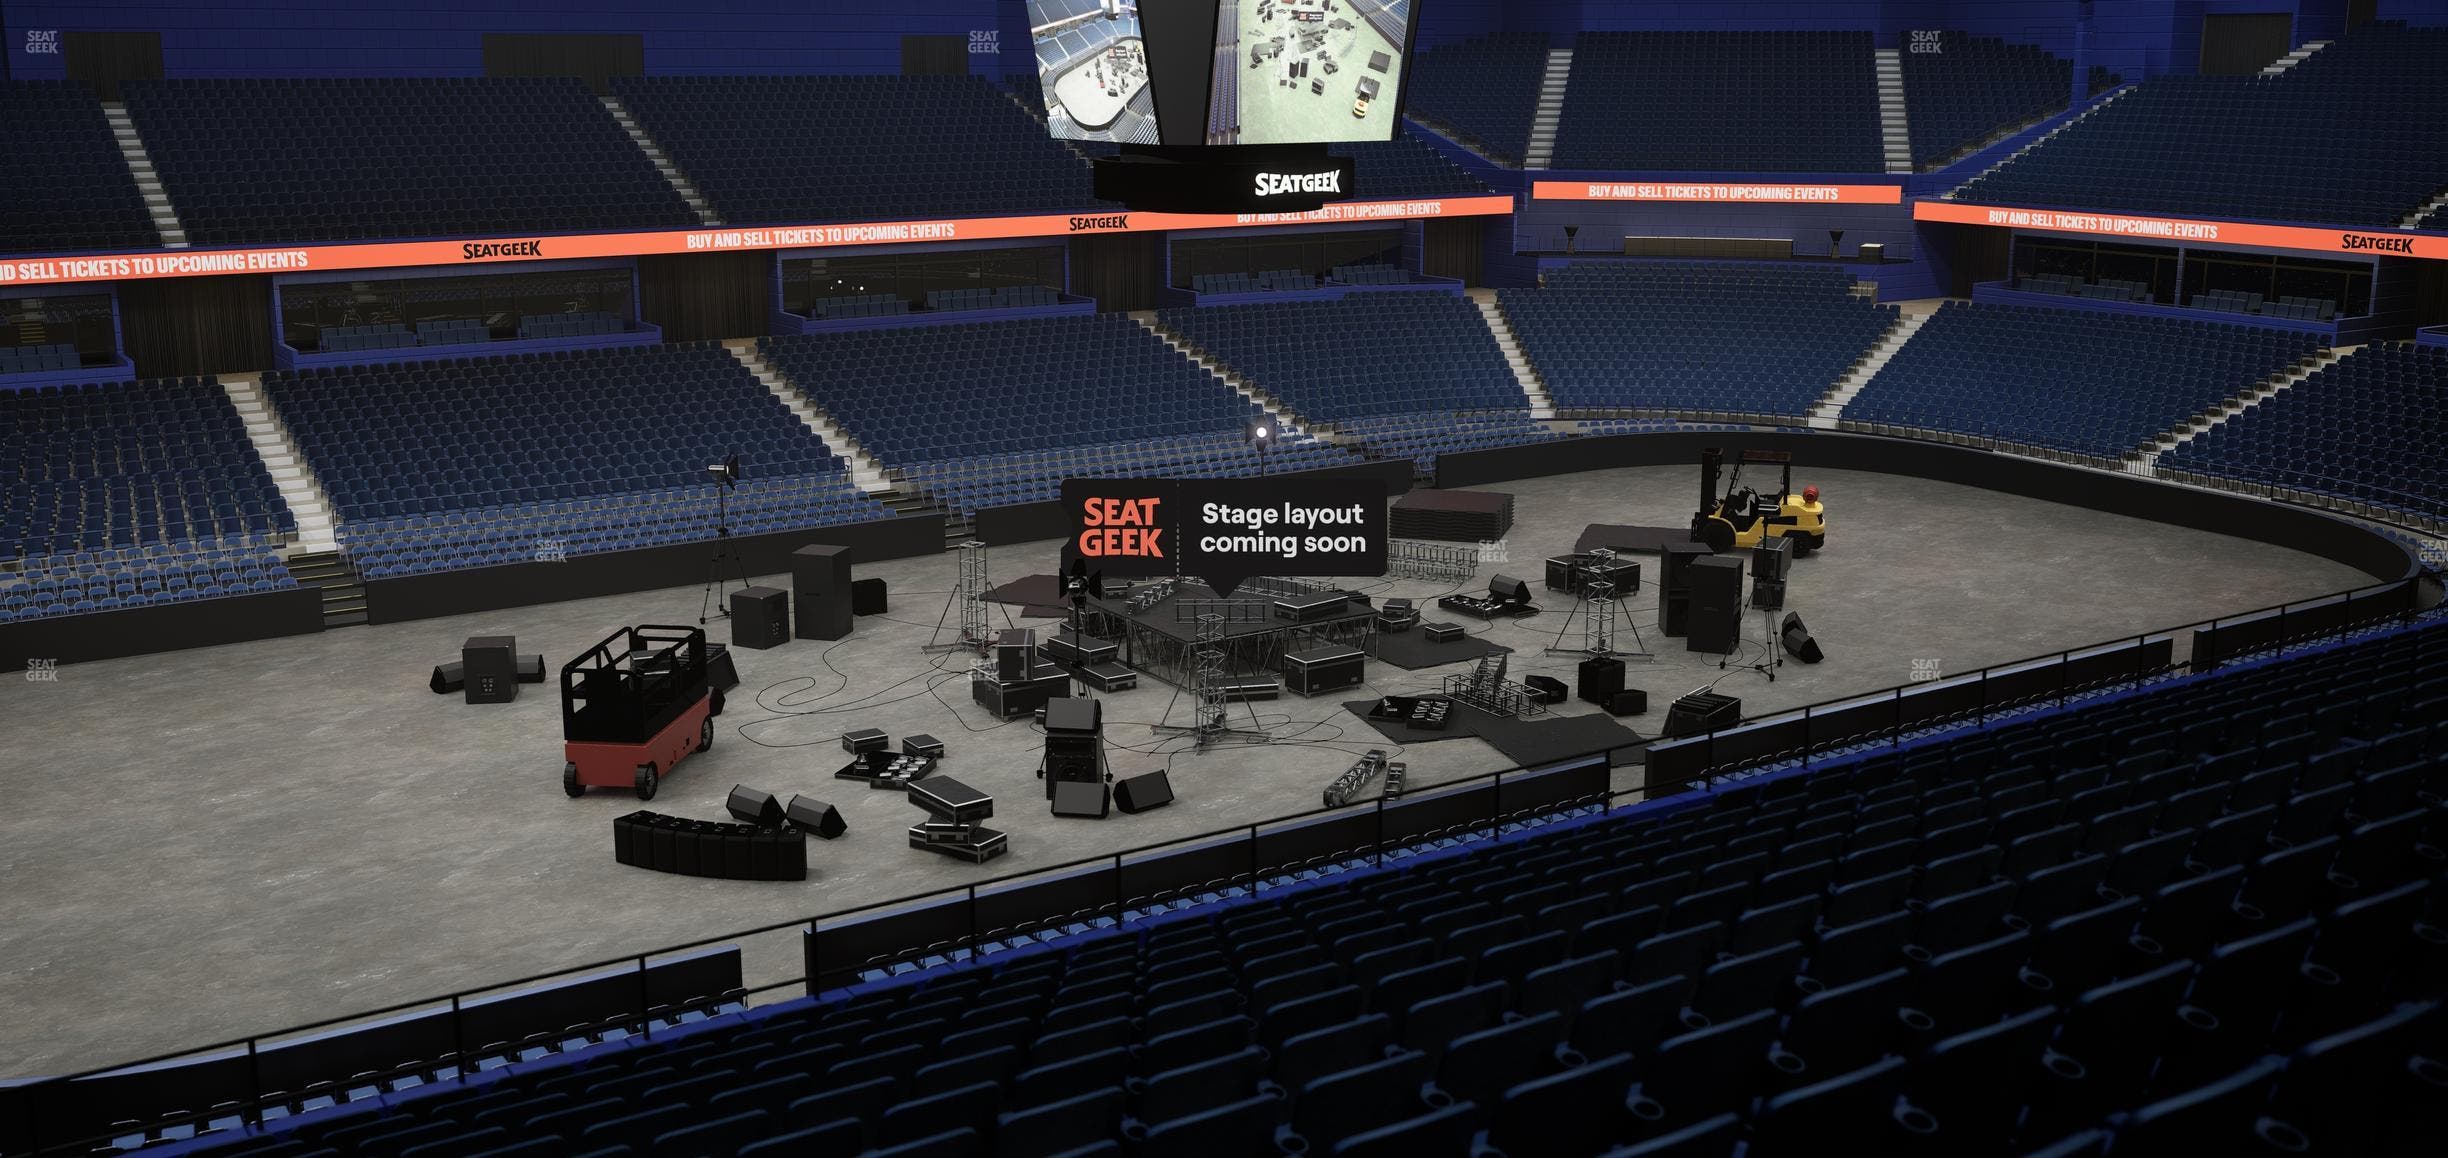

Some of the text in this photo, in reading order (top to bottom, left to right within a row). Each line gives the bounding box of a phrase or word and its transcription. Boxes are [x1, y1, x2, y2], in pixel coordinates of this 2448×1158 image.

[1255, 169, 1341, 196] SEATGEEK
[1588, 185, 1838, 200] BUY AND SELL TICKETS TO UPCOMING EVENTS
[1069, 215, 1128, 231] SEATGEEK
[1237, 213, 1257, 223] BUY
[1258, 213, 1278, 223] AND
[1304, 206, 1341, 220] TICKETS
[1342, 206, 1355, 218] TO
[1356, 203, 1406, 217] UPCOMING
[1407, 202, 1441, 215] EVENTS
[1989, 210, 2217, 239] BUY AND SELL TICKETS TO UPCOMING EVENTS
[463, 239, 542, 259] SEATGEEK
[687, 223, 954, 249] BUY AND SELL TICKETS TO UPCOMING EVENTS
[2342, 233, 2414, 254] SEATGEEK
[18, 262, 59, 280] SELL
[59, 258, 130, 279] TICKETS
[131, 257, 154, 275] TO
[157, 253, 246, 273] UPCOMING
[248, 251, 308, 269] EVENTS
[1084, 497, 1160, 526] SEAT
[1202, 502, 1364, 529] Stage layout
[1079, 528, 1163, 558] GEEK
[1200, 531, 1366, 558] coming soon
